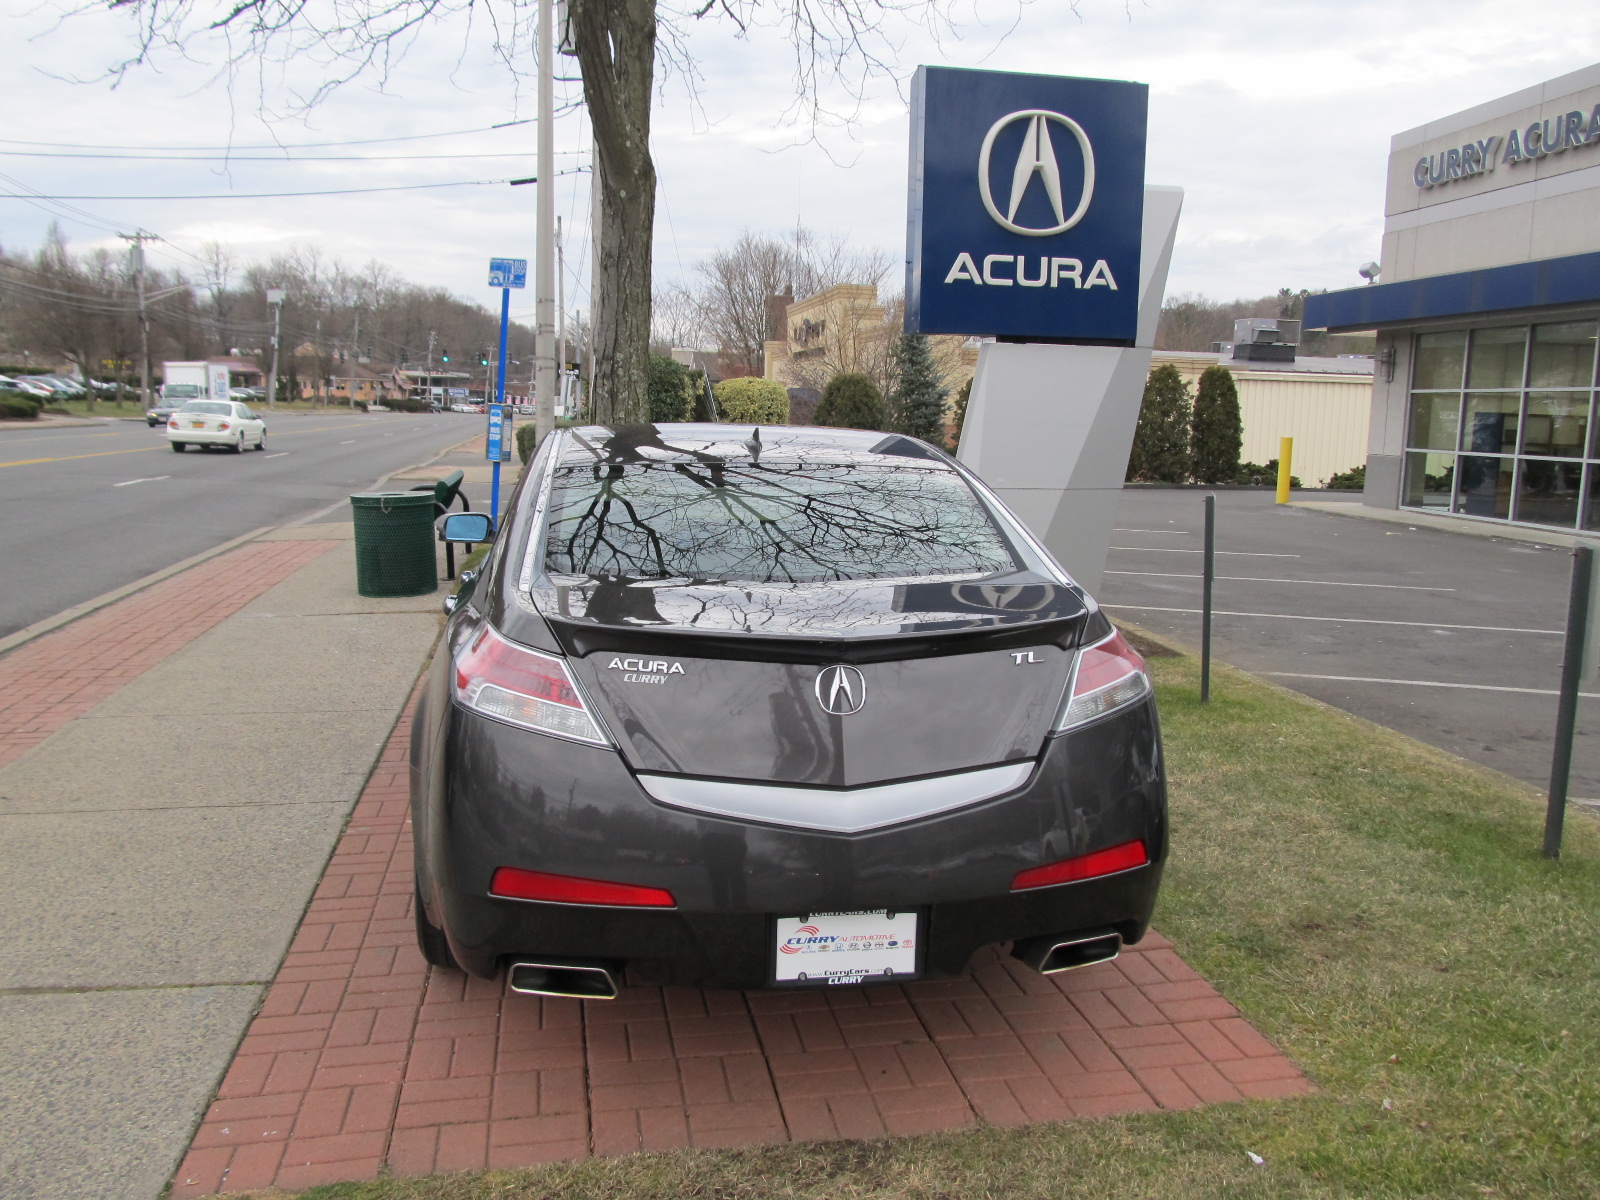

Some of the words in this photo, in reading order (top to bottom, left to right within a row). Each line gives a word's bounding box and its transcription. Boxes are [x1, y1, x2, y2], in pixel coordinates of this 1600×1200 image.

[1413, 135, 1502, 189] CURRY
[1501, 102, 1600, 165] ACURA
[514, 260, 526, 268] BUS
[943, 252, 1119, 291] ACURA
[1010, 651, 1045, 666] TL
[607, 657, 686, 675] ACURA
[623, 673, 669, 685] CURRY
[786, 935, 840, 945] CURRY
[838, 934, 897, 943] AUTOMOTIVE
[828, 975, 865, 985] CURRY
